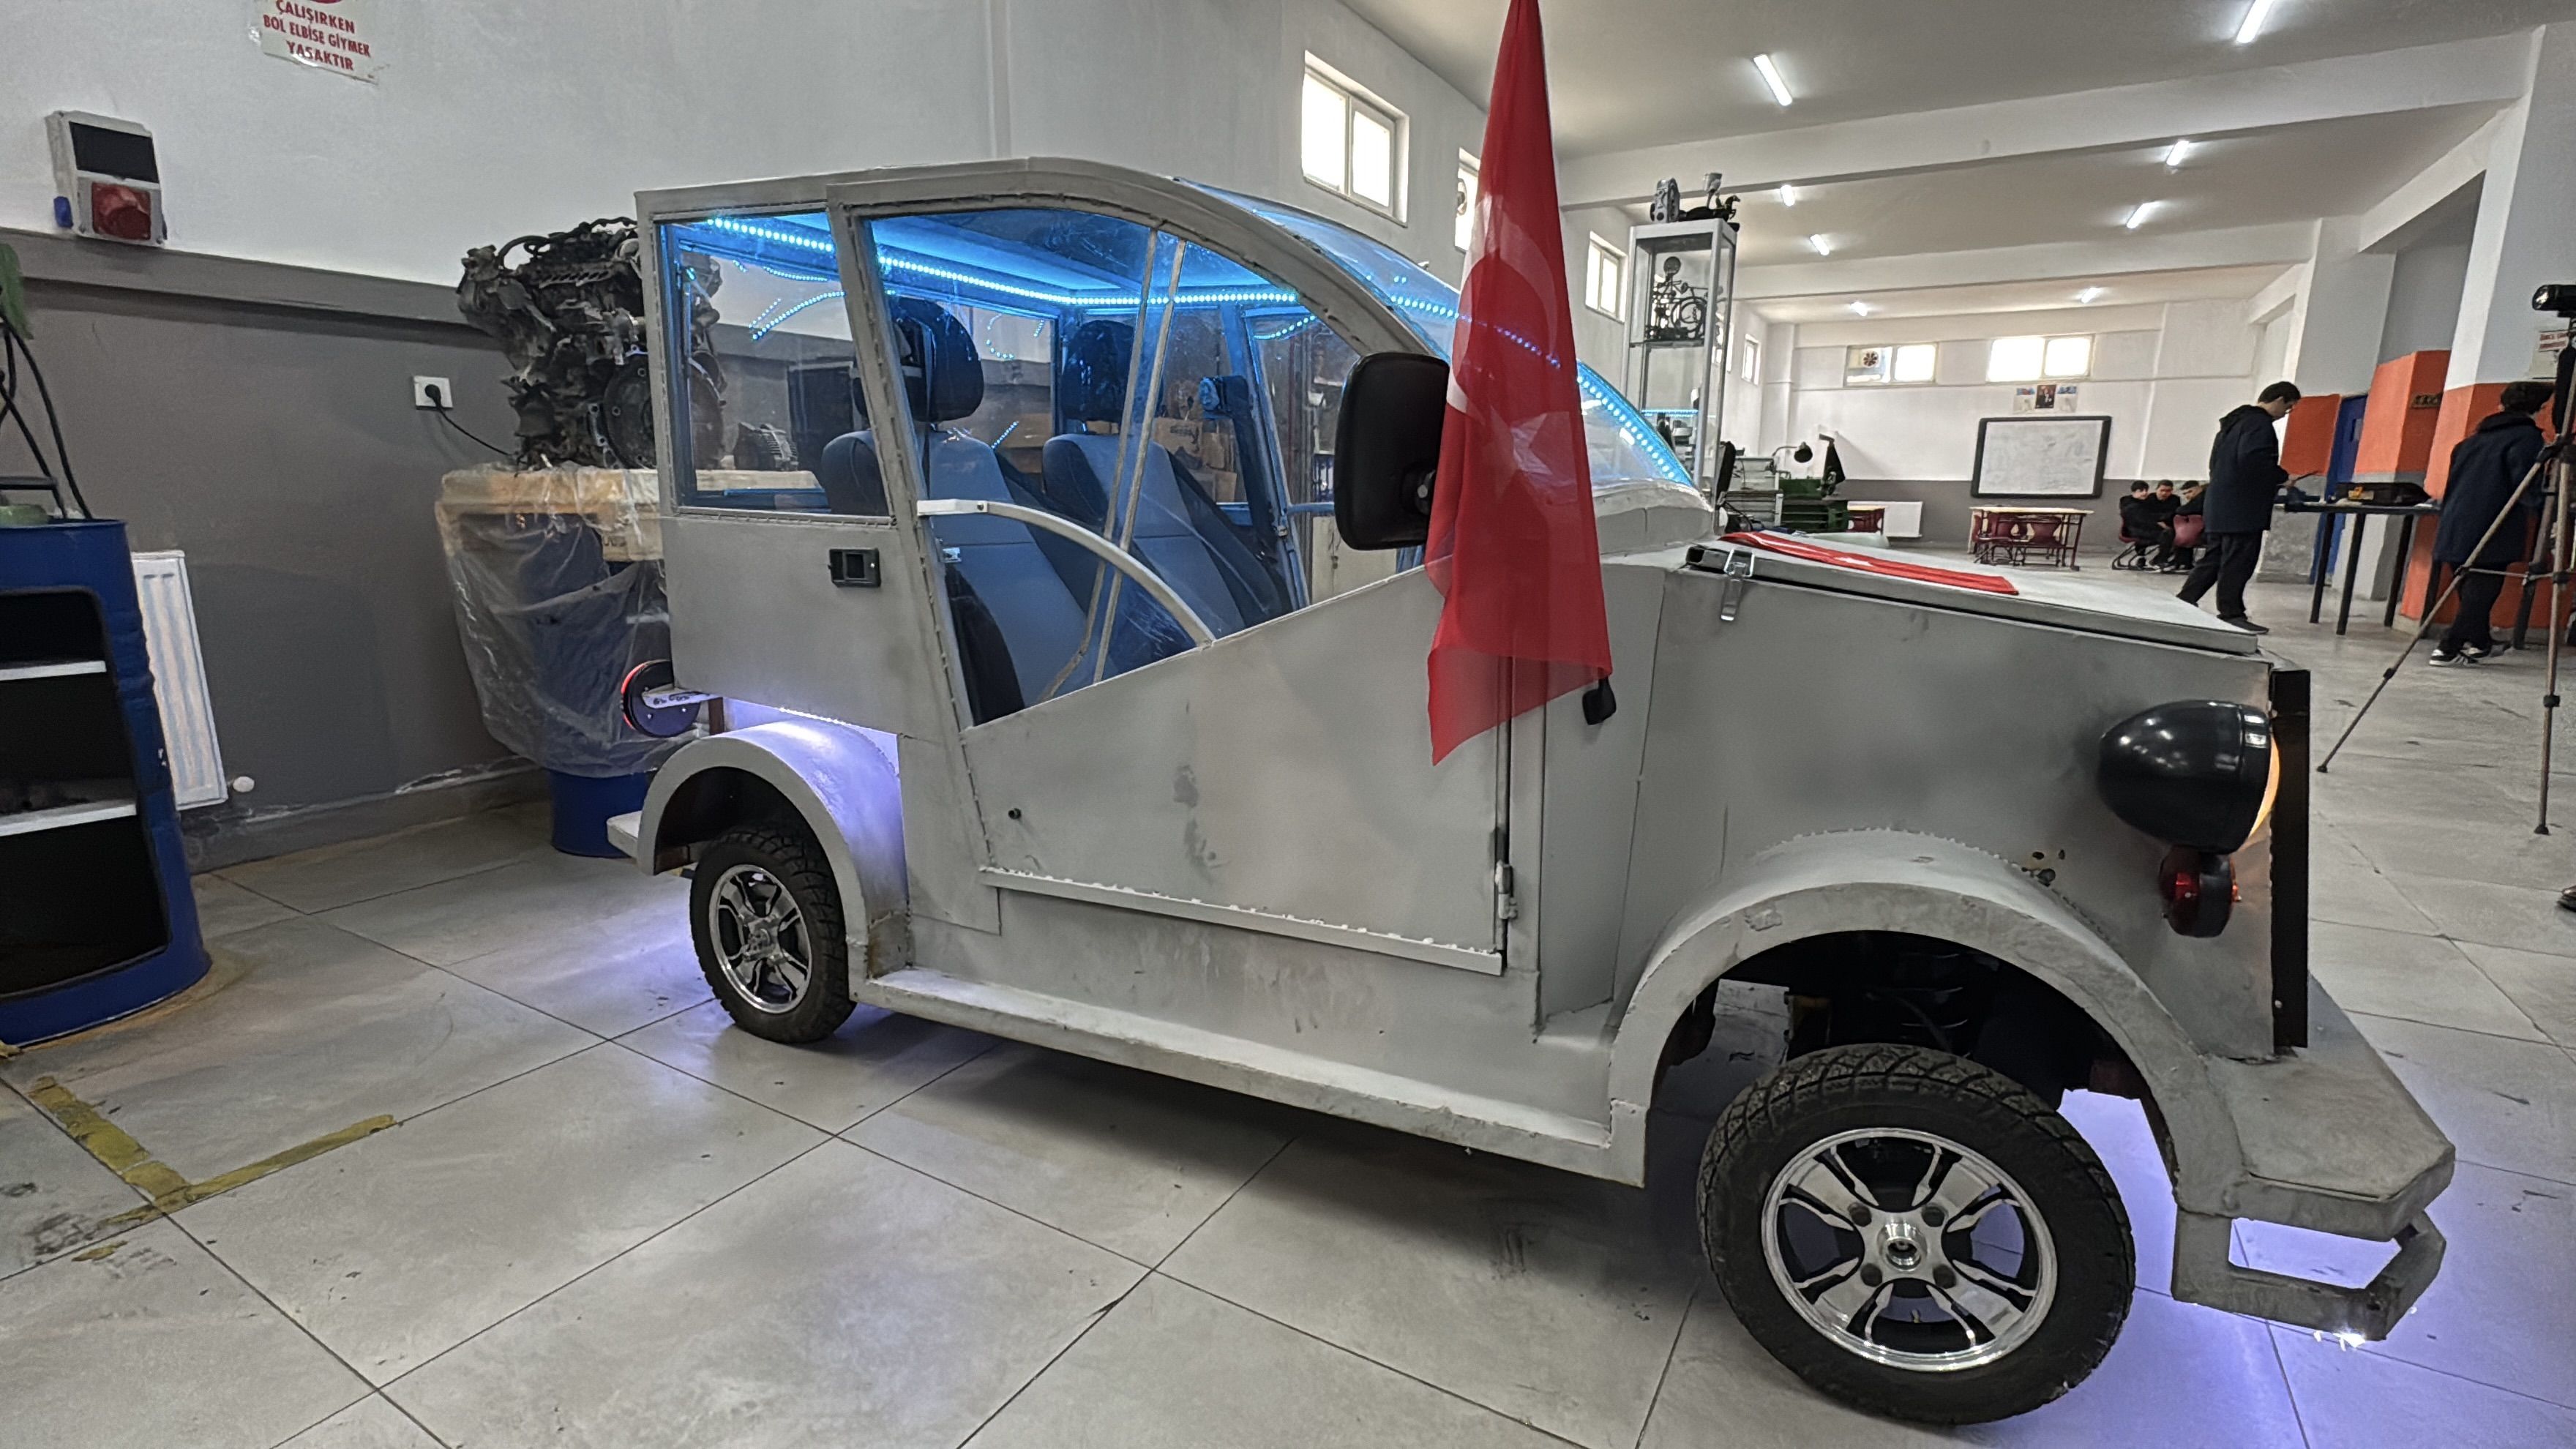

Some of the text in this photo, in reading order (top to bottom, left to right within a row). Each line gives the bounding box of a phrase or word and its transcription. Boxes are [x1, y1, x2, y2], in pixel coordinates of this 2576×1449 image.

[263, 14, 287, 33] BOL
[288, 21, 326, 45] ELBİSE
[275, 0, 356, 34] ÇALIŞIRKEN
[285, 40, 354, 71] YASAKTIR
